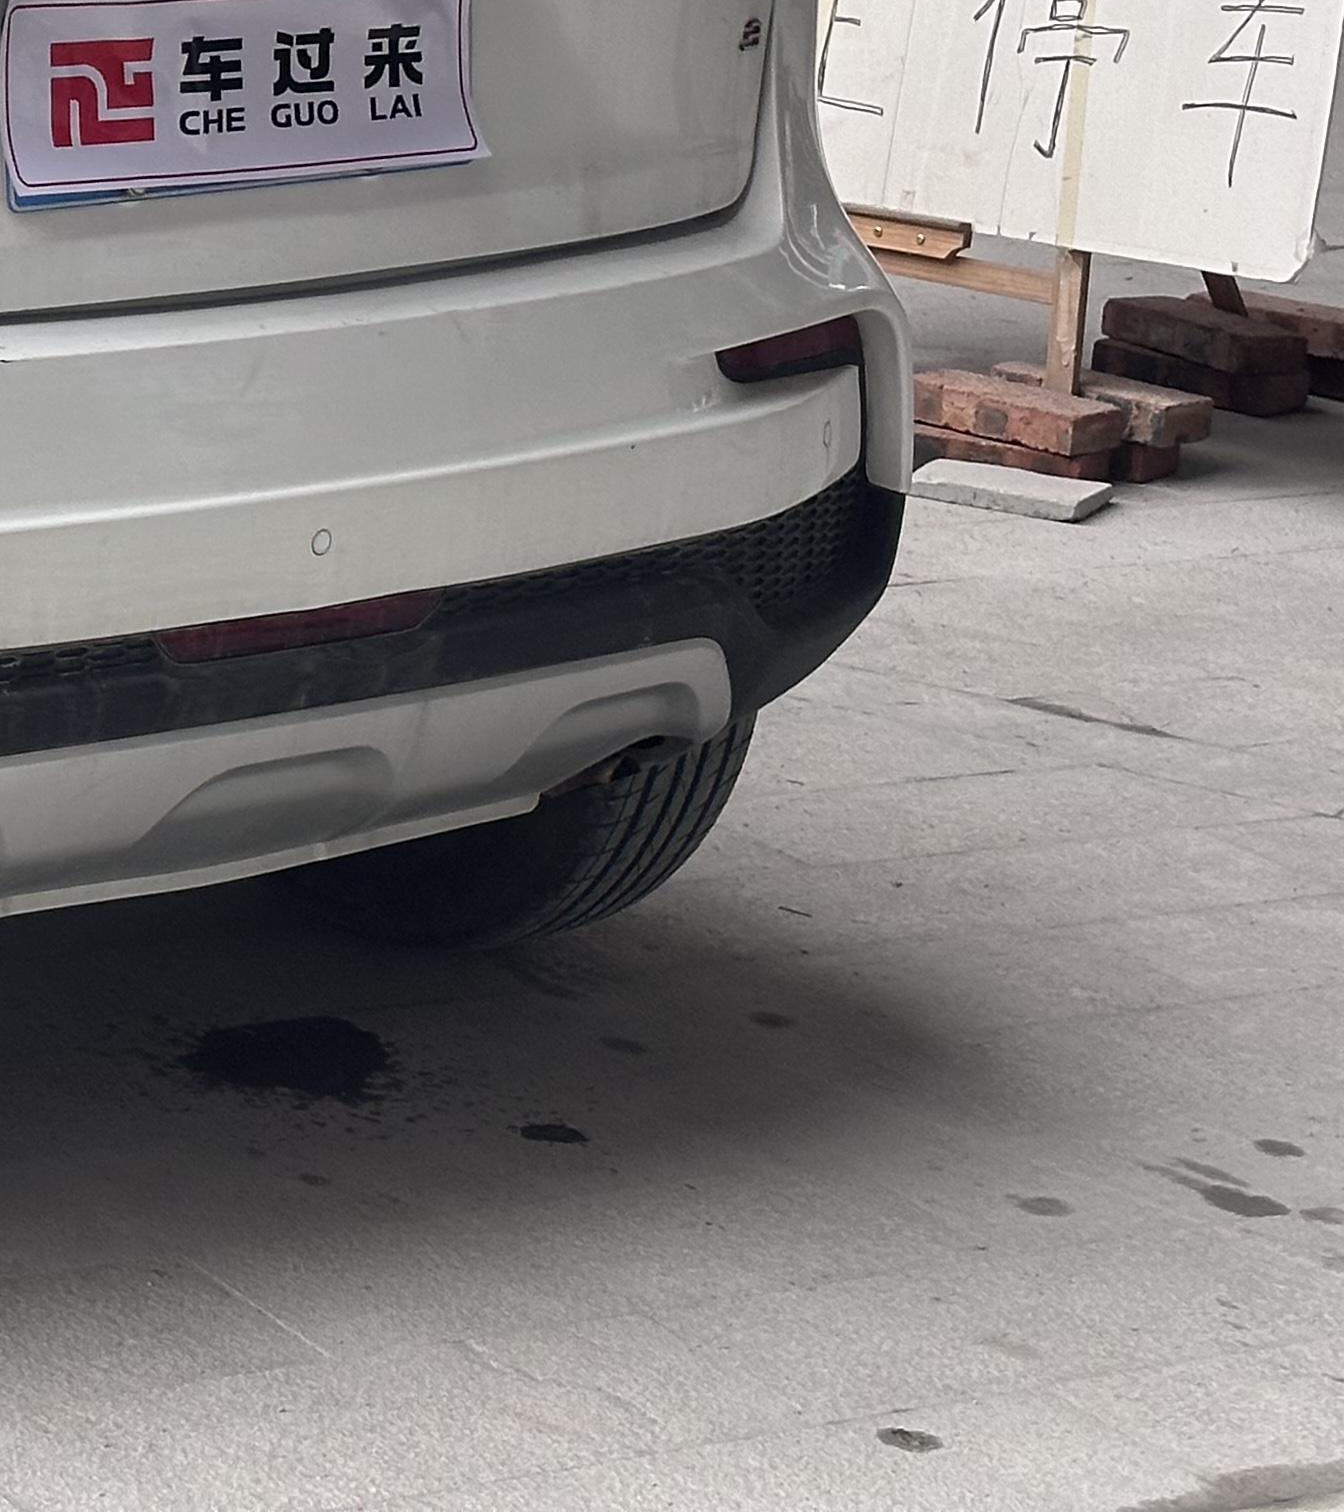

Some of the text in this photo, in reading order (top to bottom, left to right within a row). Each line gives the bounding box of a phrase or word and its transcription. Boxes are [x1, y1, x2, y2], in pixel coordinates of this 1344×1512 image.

[178, 23, 425, 102] 车过来
[178, 92, 423, 136] CHE GUO LAI
